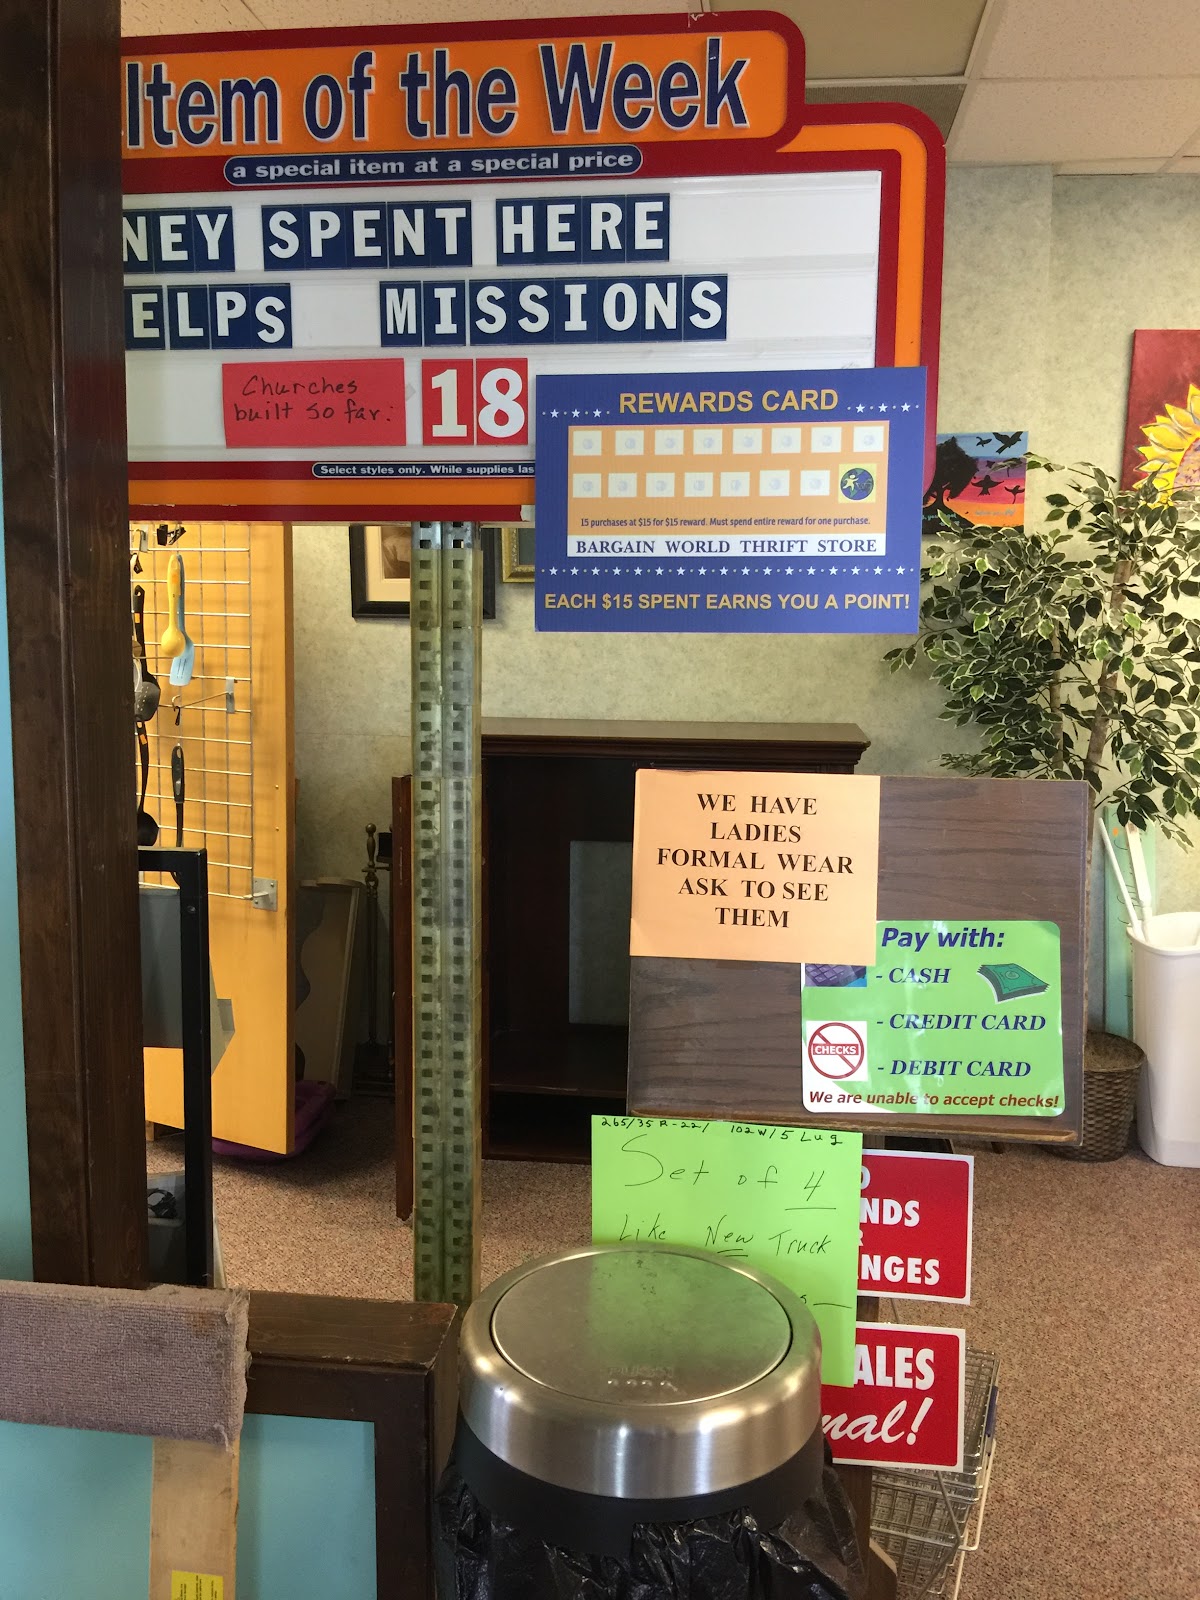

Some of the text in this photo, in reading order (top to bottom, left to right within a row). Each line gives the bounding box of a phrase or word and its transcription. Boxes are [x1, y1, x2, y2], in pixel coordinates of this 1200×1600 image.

[126, 36, 750, 149] Item of the Week
[232, 152, 634, 178] a special item at a special price
[268, 207, 467, 259] SPENT
[501, 201, 664, 254] HERE
[131, 280, 722, 343] ELPS MISSIONS
[242, 375, 358, 396] Churches
[233, 402, 293, 422] built
[431, 366, 527, 438] 18
[619, 388, 839, 414] REWARDS CARD
[320, 465, 357, 475] Select
[360, 465, 395, 476] styles
[398, 465, 426, 476] only.
[430, 465, 462, 475] While
[466, 464, 514, 476] supplies
[581, 516, 871, 528] 15 purchases at $15 for $15 reward. Must spend entire reward for one purchase.
[576, 539, 877, 554] BARGAIN WORLD THRIFT STORE
[544, 591, 910, 611] EACH $15 SPENT EARNS YOU A POINT!
[697, 793, 818, 816] WE HAVE
[710, 821, 802, 844] LADIES
[657, 848, 855, 875] FORMAL WEAR
[678, 877, 829, 902] ASK TO SEE
[714, 907, 790, 929] THEM
[881, 927, 1005, 952] Pay with:
[888, 967, 952, 985] CASH
[889, 1013, 977, 1031] CREDIT
[981, 1014, 1046, 1031] CARD
[814, 1044, 857, 1056] CHECKS
[890, 1060, 962, 1077] DEBIT
[966, 1061, 1032, 1078] CARD
[809, 1091, 1060, 1109] We are unable to accept checks!
[621, 1133, 710, 1187] Set
[737, 1165, 779, 1190] of
[802, 1170, 825, 1202] 4
[619, 1212, 667, 1242] Like
[704, 1214, 755, 1247] New
[768, 1229, 832, 1257] Truck
